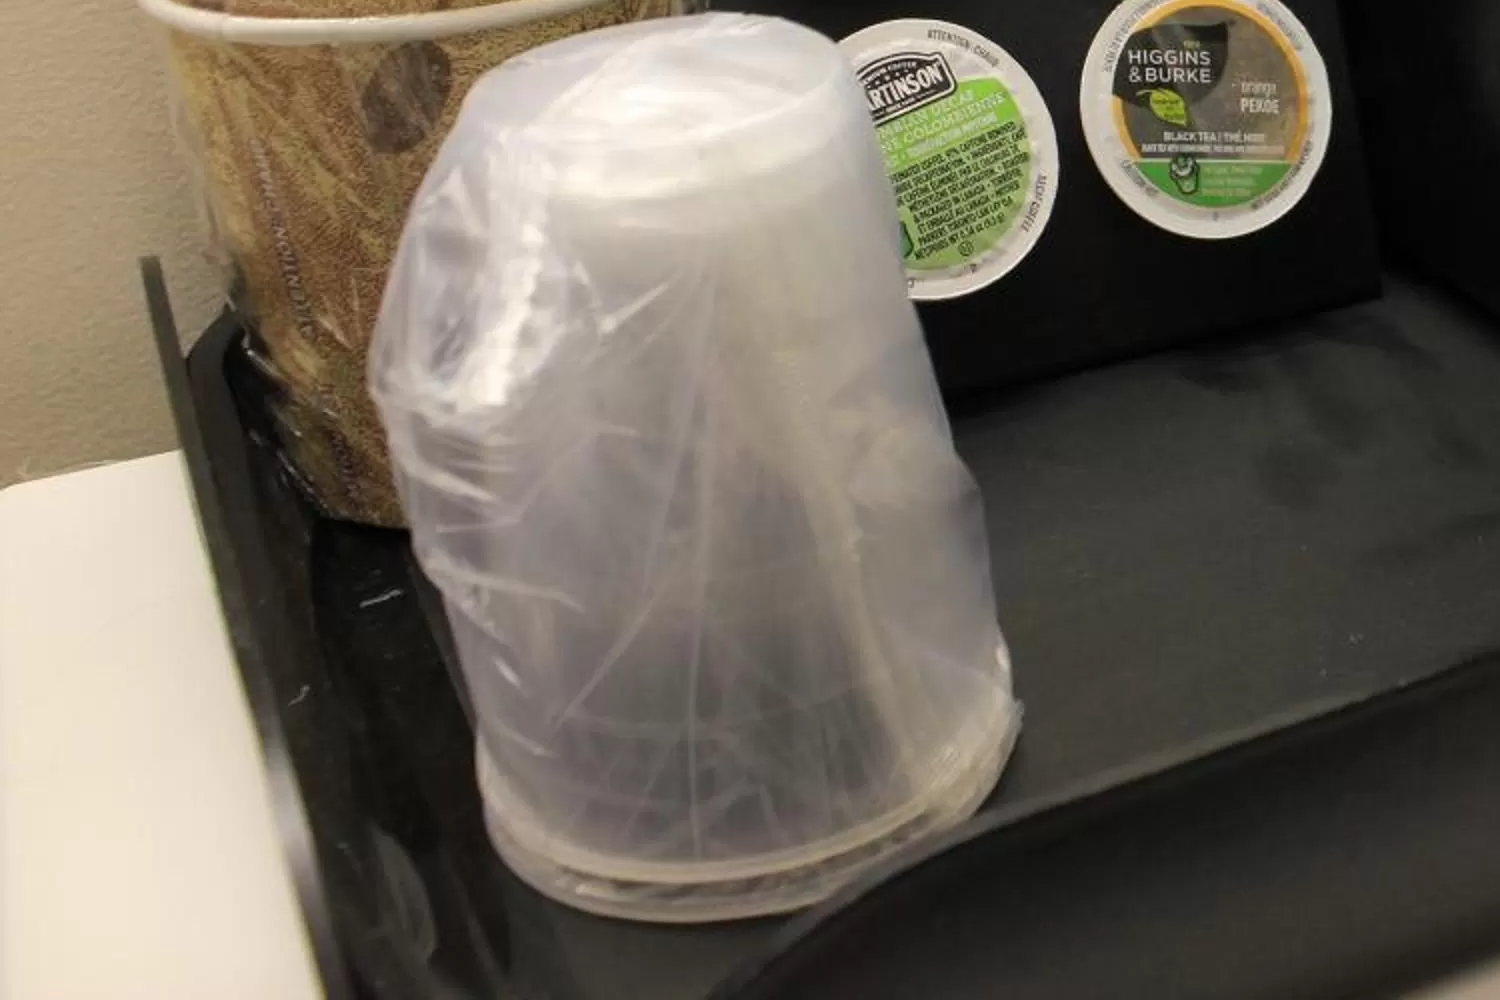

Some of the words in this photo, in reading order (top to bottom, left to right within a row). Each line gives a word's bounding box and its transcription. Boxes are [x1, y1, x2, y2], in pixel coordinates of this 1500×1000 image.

[1128, 49, 1211, 66] HIGGINS
[1128, 67, 1142, 83] &
[1145, 67, 1212, 83] BURKE
[867, 61, 943, 111] RTINSON
[1240, 98, 1280, 114] PEKOE
[1163, 131, 1195, 143] BLACK
[1196, 131, 1217, 142] TEA
